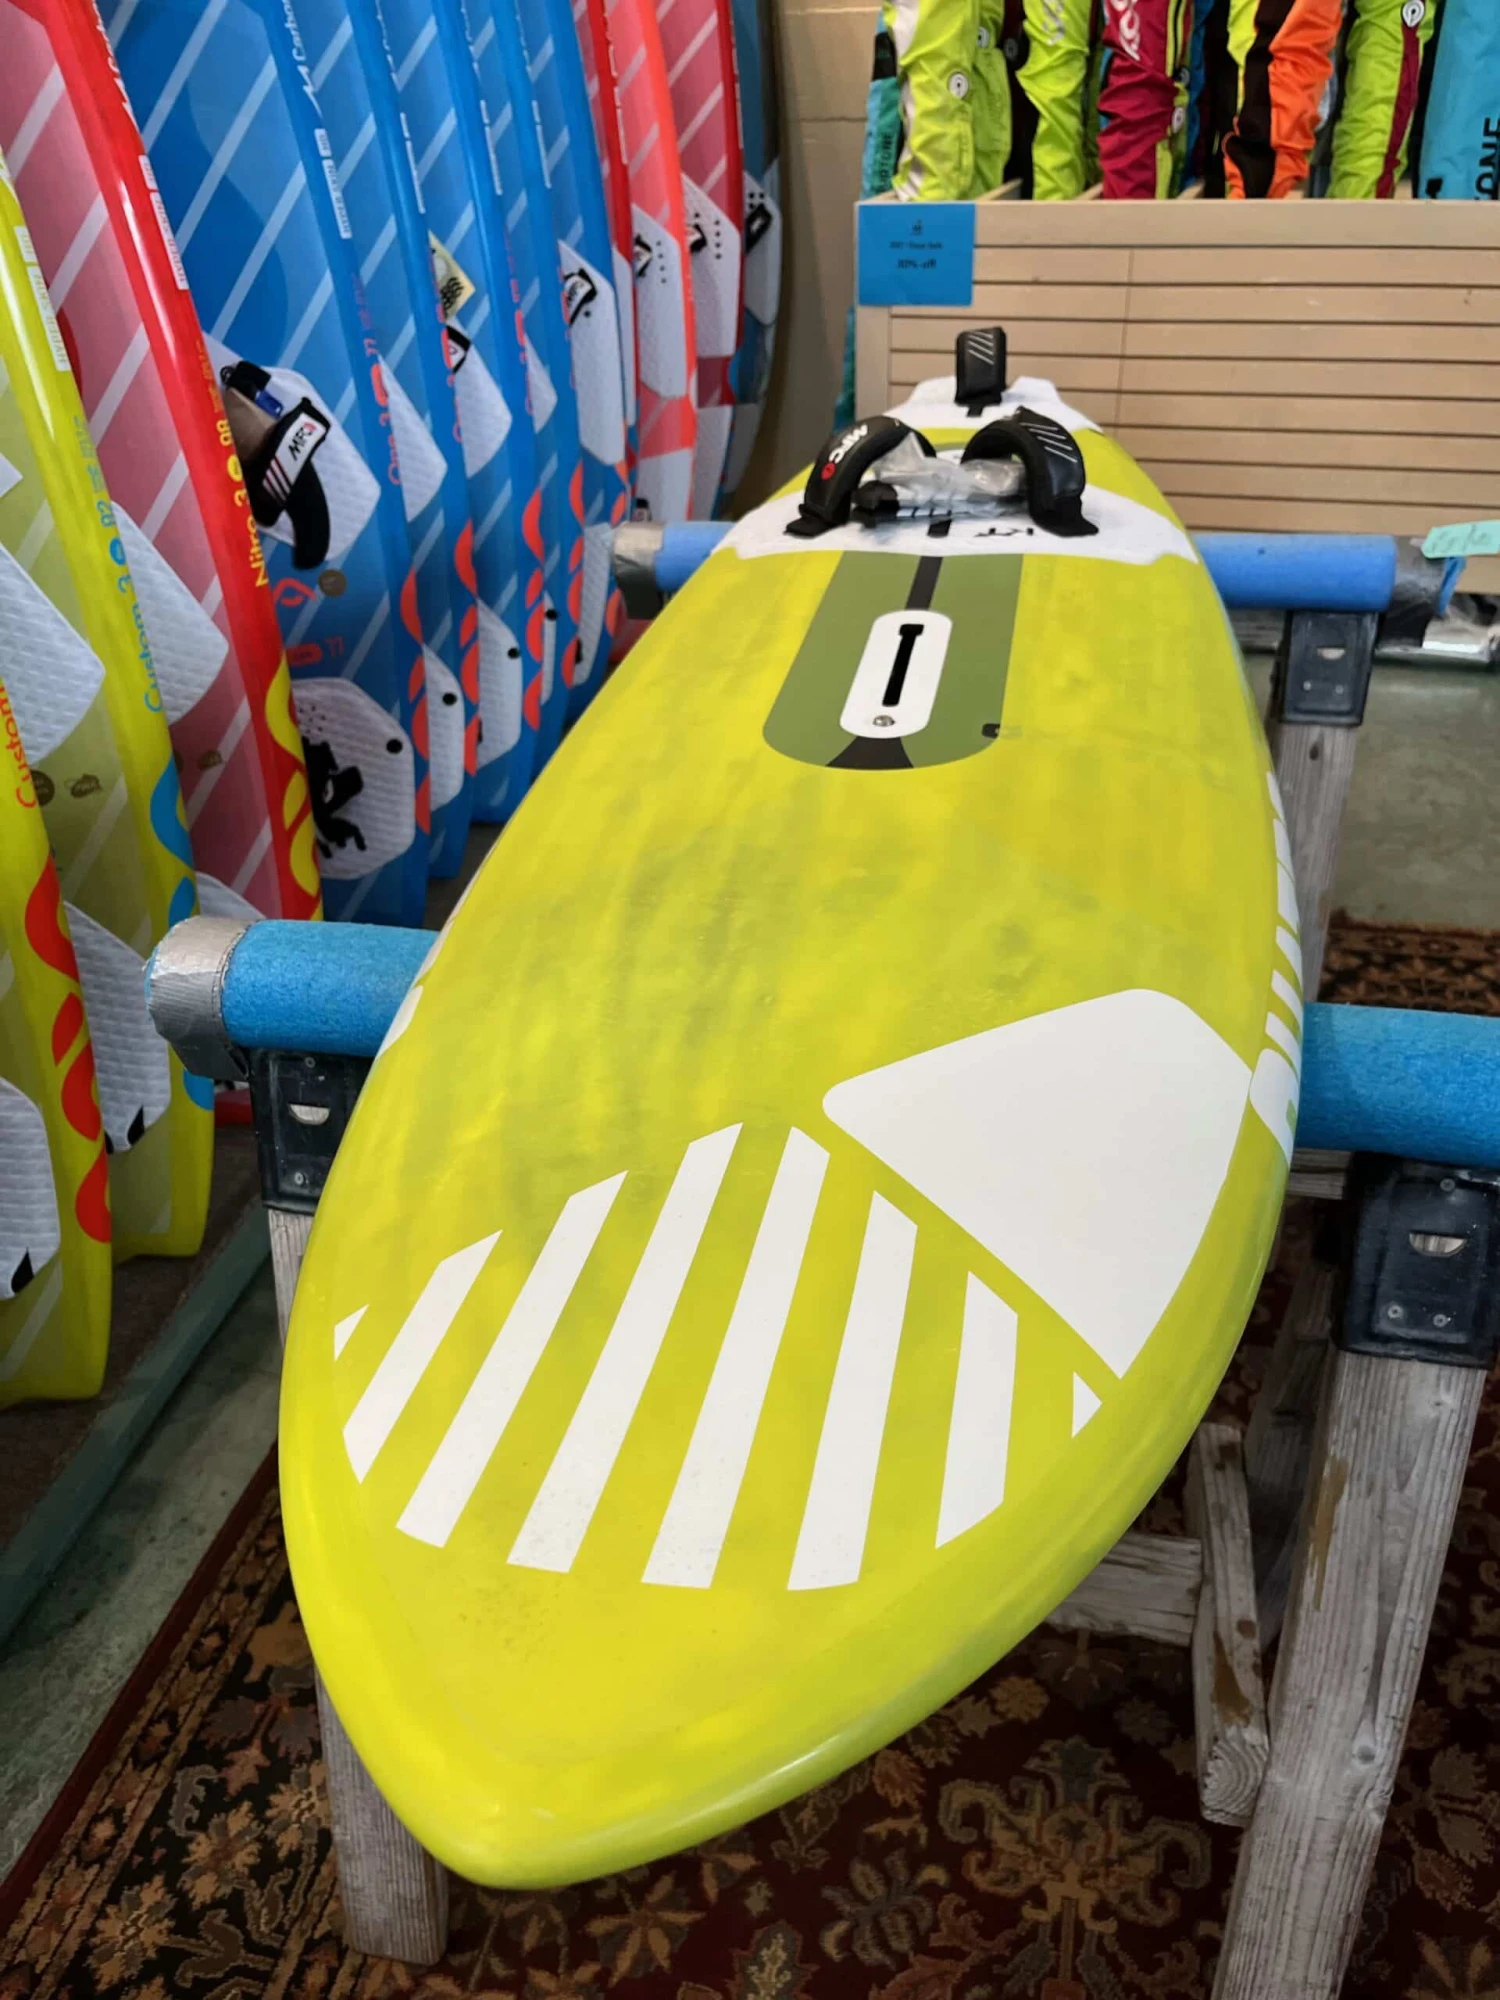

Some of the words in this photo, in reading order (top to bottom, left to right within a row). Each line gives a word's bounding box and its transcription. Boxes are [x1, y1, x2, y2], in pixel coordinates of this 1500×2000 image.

[281, 0, 306, 61] Carbo
[155, 199, 170, 233] SKIN
[168, 237, 186, 283] HYPER
[828, 424, 868, 464] MFC
